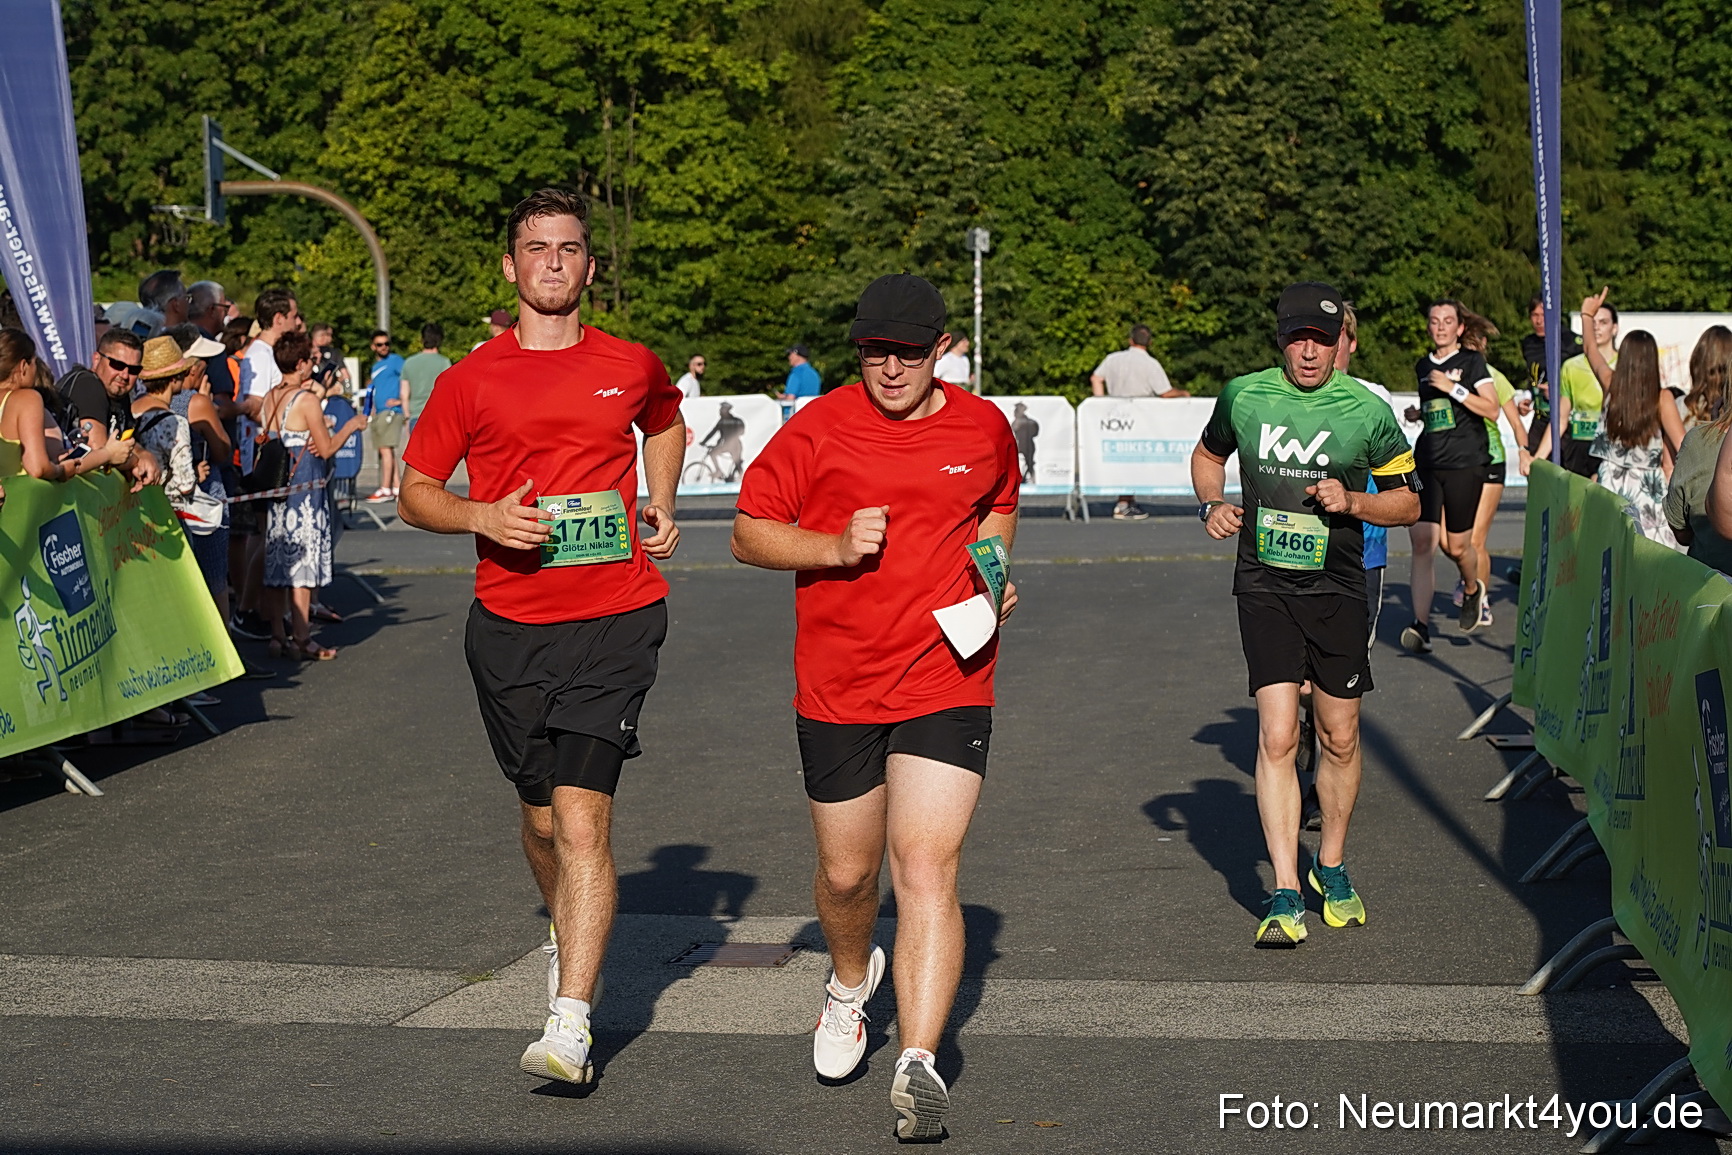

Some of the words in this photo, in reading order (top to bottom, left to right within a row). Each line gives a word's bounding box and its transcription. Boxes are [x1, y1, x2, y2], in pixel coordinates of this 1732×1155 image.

[1100, 418, 1135, 431] NOW
[1258, 464, 1276, 475] KW
[1279, 467, 1328, 479] ENERGIE
[556, 515, 617, 543] 1715
[617, 516, 628, 550] 2022
[1267, 529, 1315, 553] 1466
[49, 542, 83, 569] Fischer
[562, 544, 587, 553] Glötzl
[589, 541, 614, 551] Niklas
[975, 544, 992, 557] RUN
[1284, 551, 1310, 560] Johann
[1314, 538, 1325, 563] 2022
[69, 654, 103, 693] neumarkt
[1706, 725, 1726, 756] Fischer
